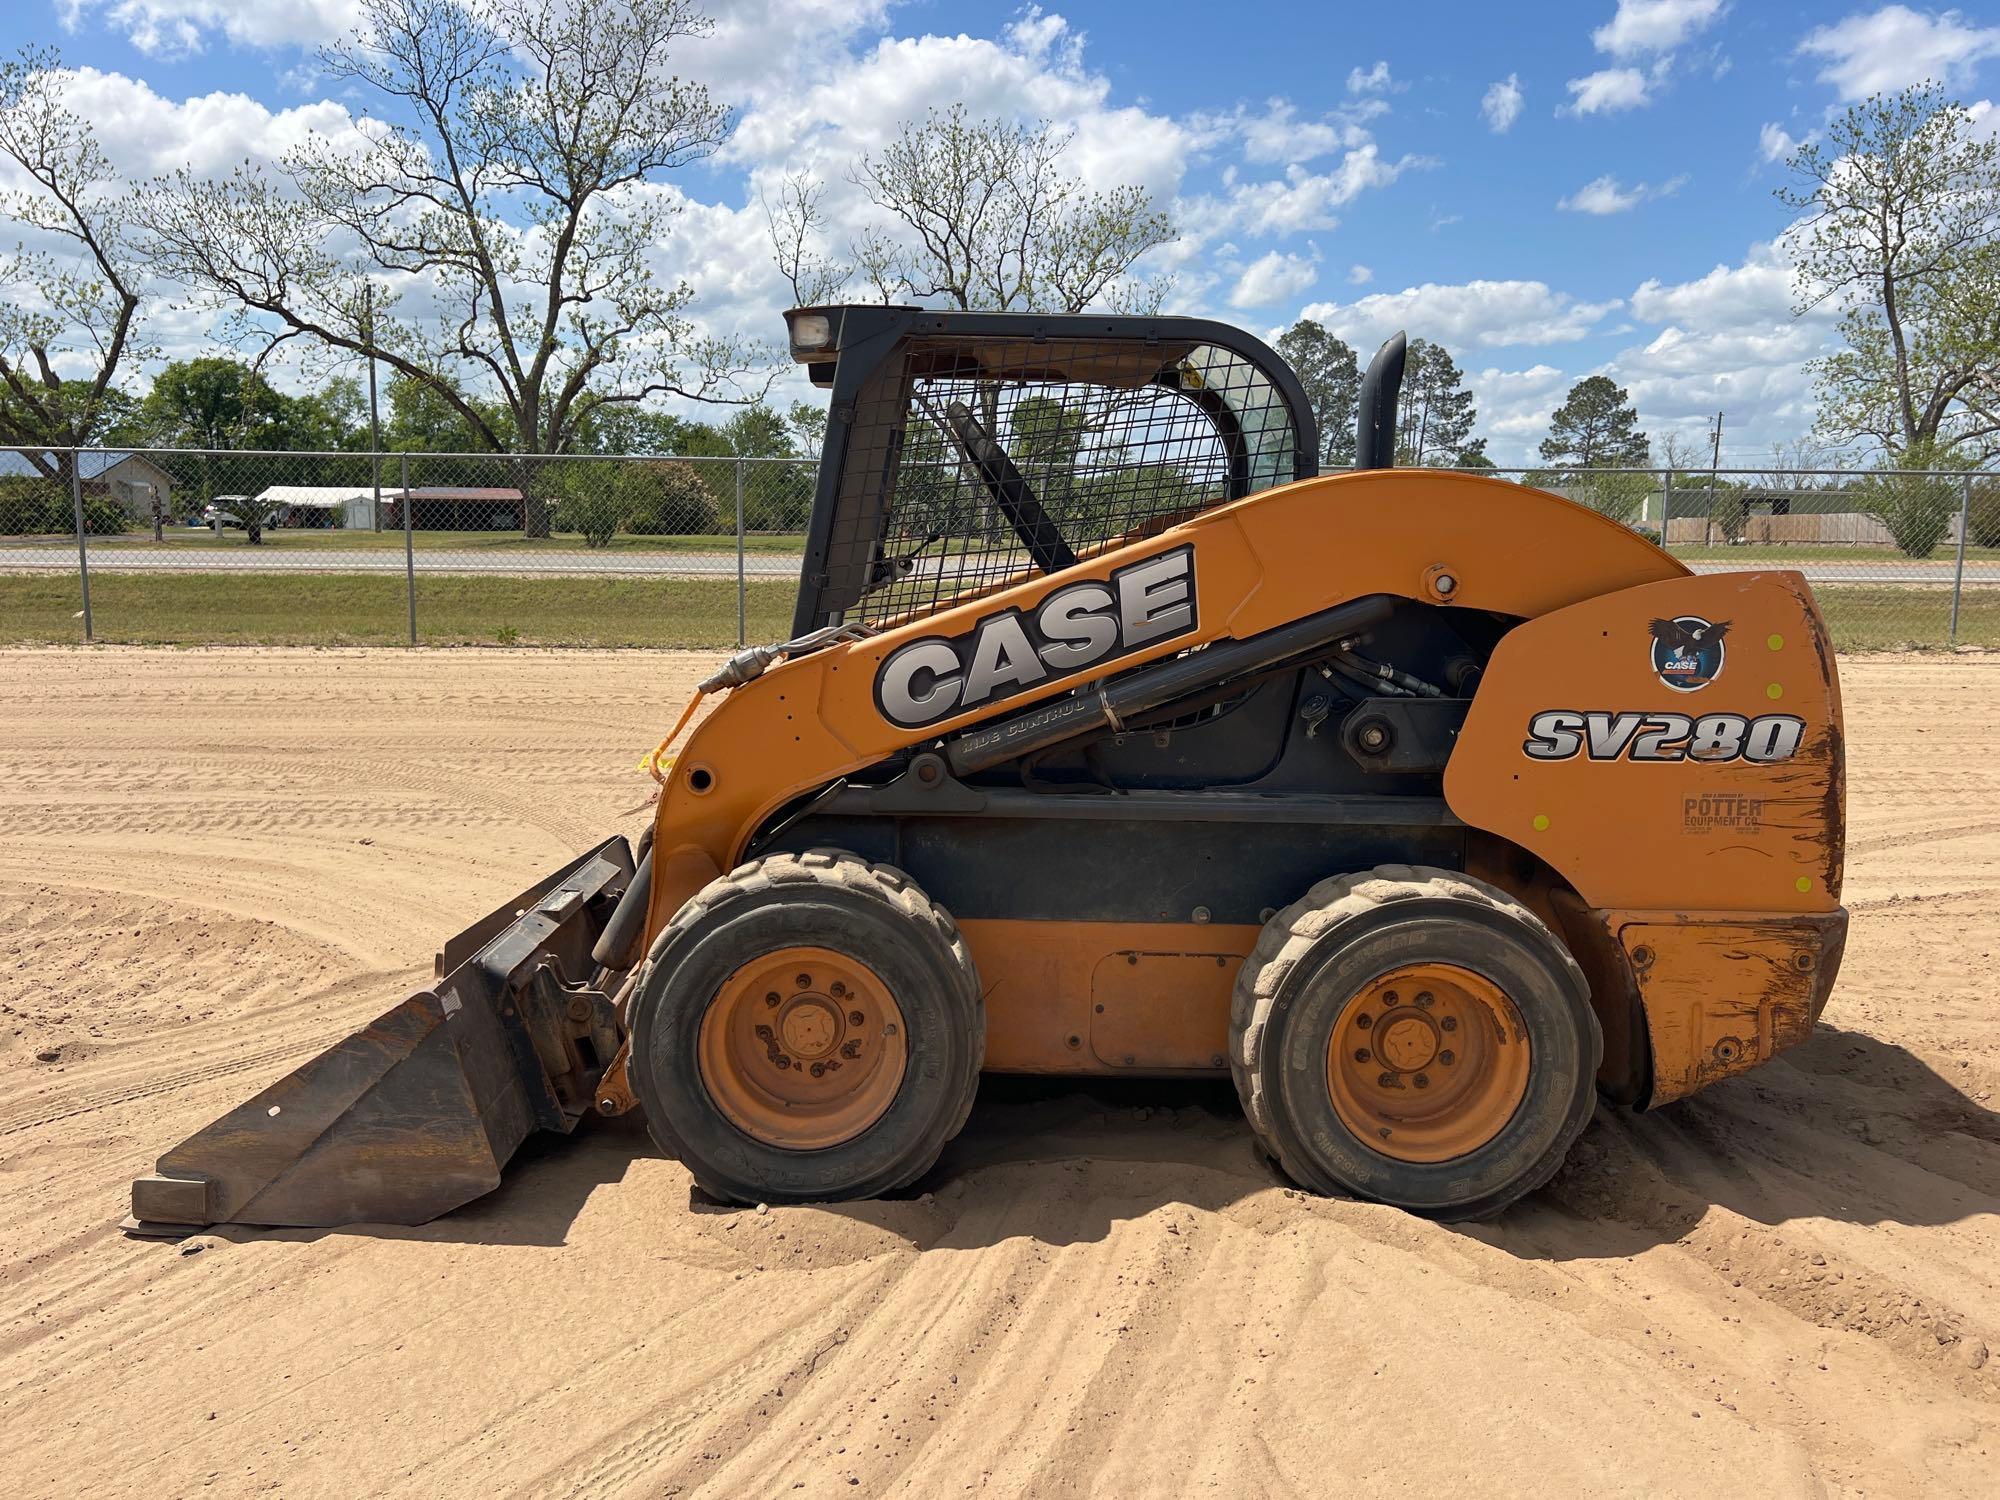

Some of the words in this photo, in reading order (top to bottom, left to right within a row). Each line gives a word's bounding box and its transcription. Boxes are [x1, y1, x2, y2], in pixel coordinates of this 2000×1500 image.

[879, 551, 1193, 726] CASE
[1664, 661, 1698, 670] CASE
[1524, 711, 1806, 764] SV280
[1684, 798, 1762, 817] POTTER
[1684, 816, 1741, 827] EQUIPMENT
